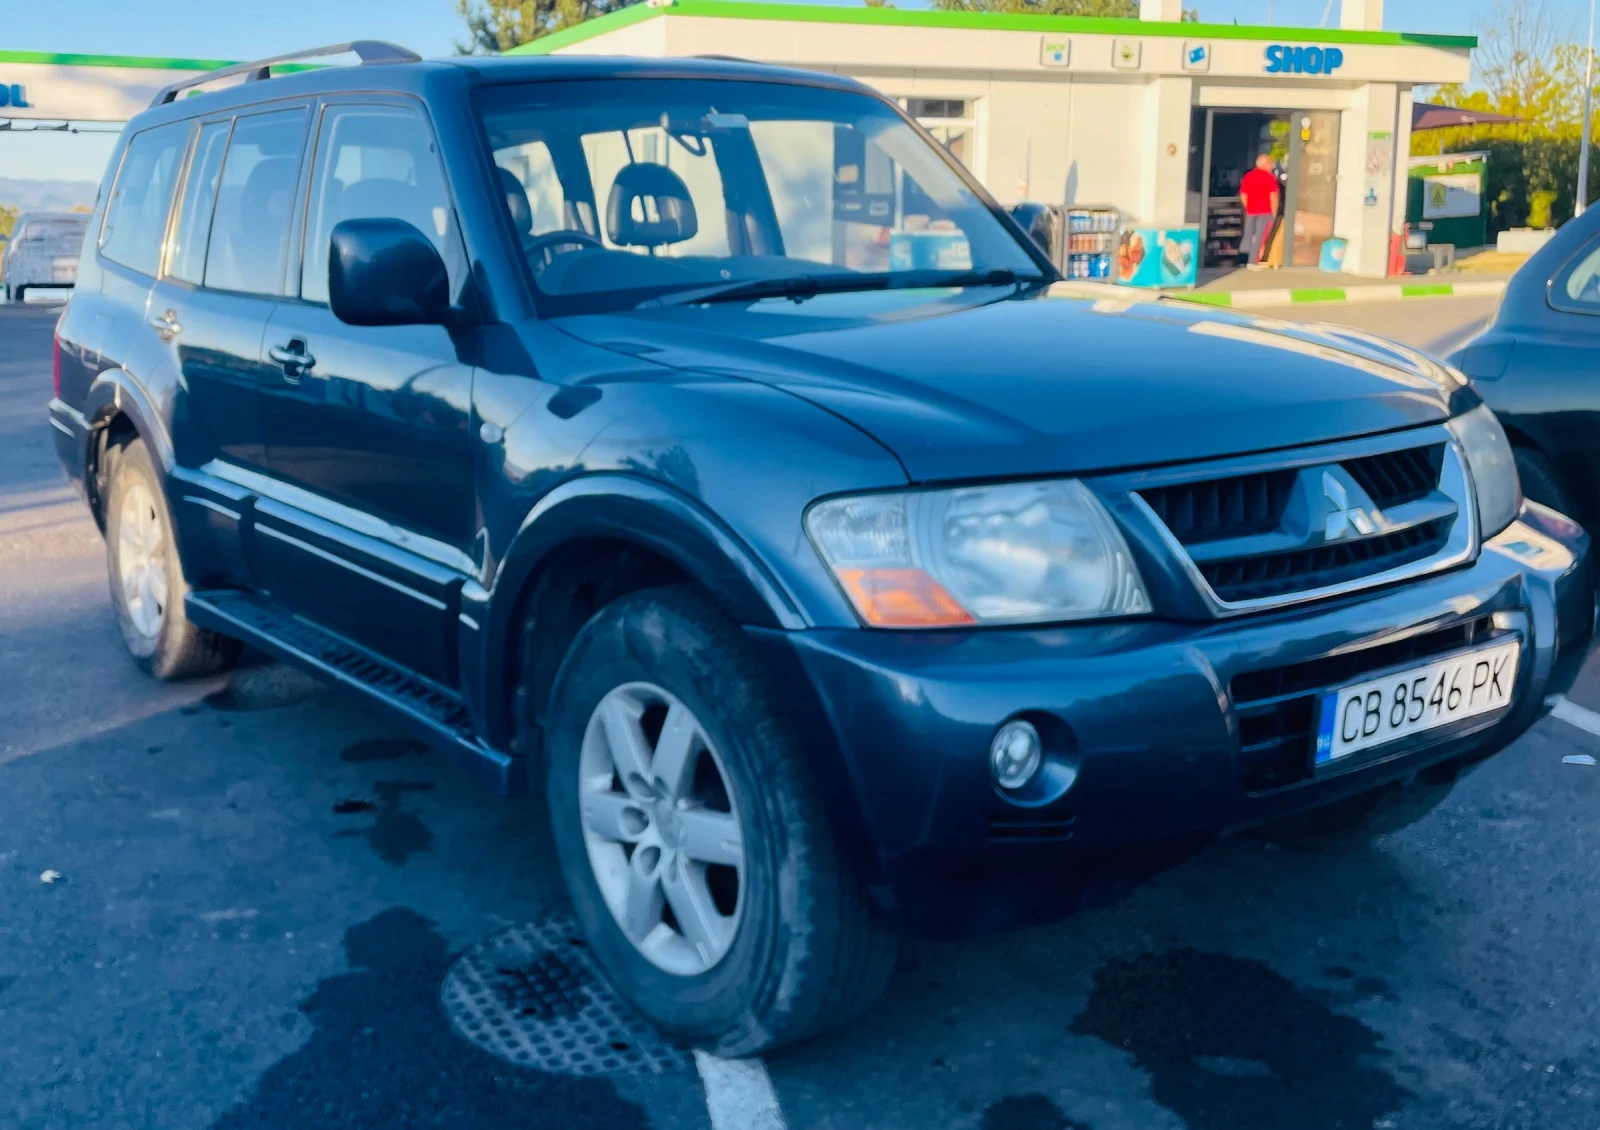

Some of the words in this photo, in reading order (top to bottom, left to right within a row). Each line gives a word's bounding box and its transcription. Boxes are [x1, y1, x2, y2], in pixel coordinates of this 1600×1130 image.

[1265, 44, 1343, 74] SHOP
[1341, 689, 1382, 743] CB
[1389, 665, 1462, 729] 8546
[1469, 654, 1509, 706] PK
